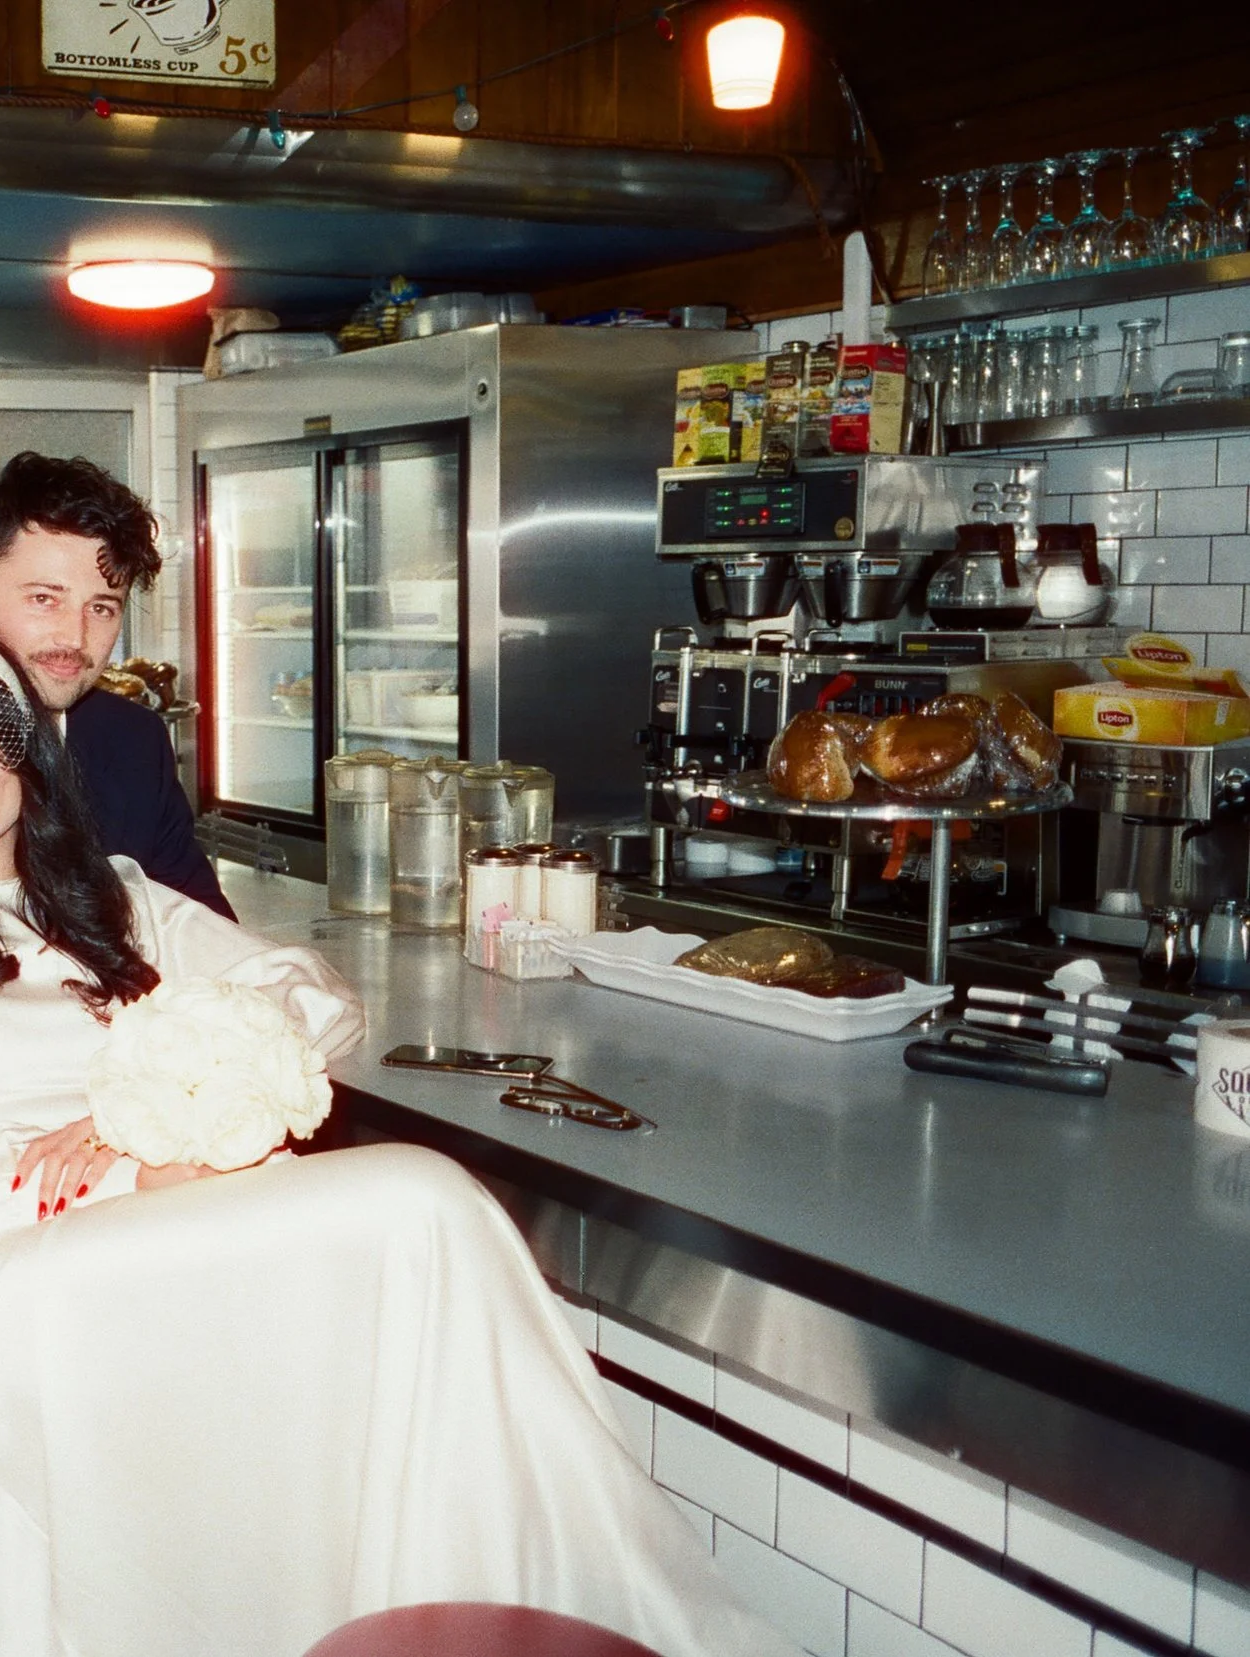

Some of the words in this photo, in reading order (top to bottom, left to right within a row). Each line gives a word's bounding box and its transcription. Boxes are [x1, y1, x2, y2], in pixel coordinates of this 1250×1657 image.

[54, 52, 161, 70] BOTTOMLESS
[166, 61, 199, 72] CUP
[1136, 648, 1184, 662] Lipton
[874, 679, 907, 690] BUNN
[1100, 712, 1130, 724] Lipton
